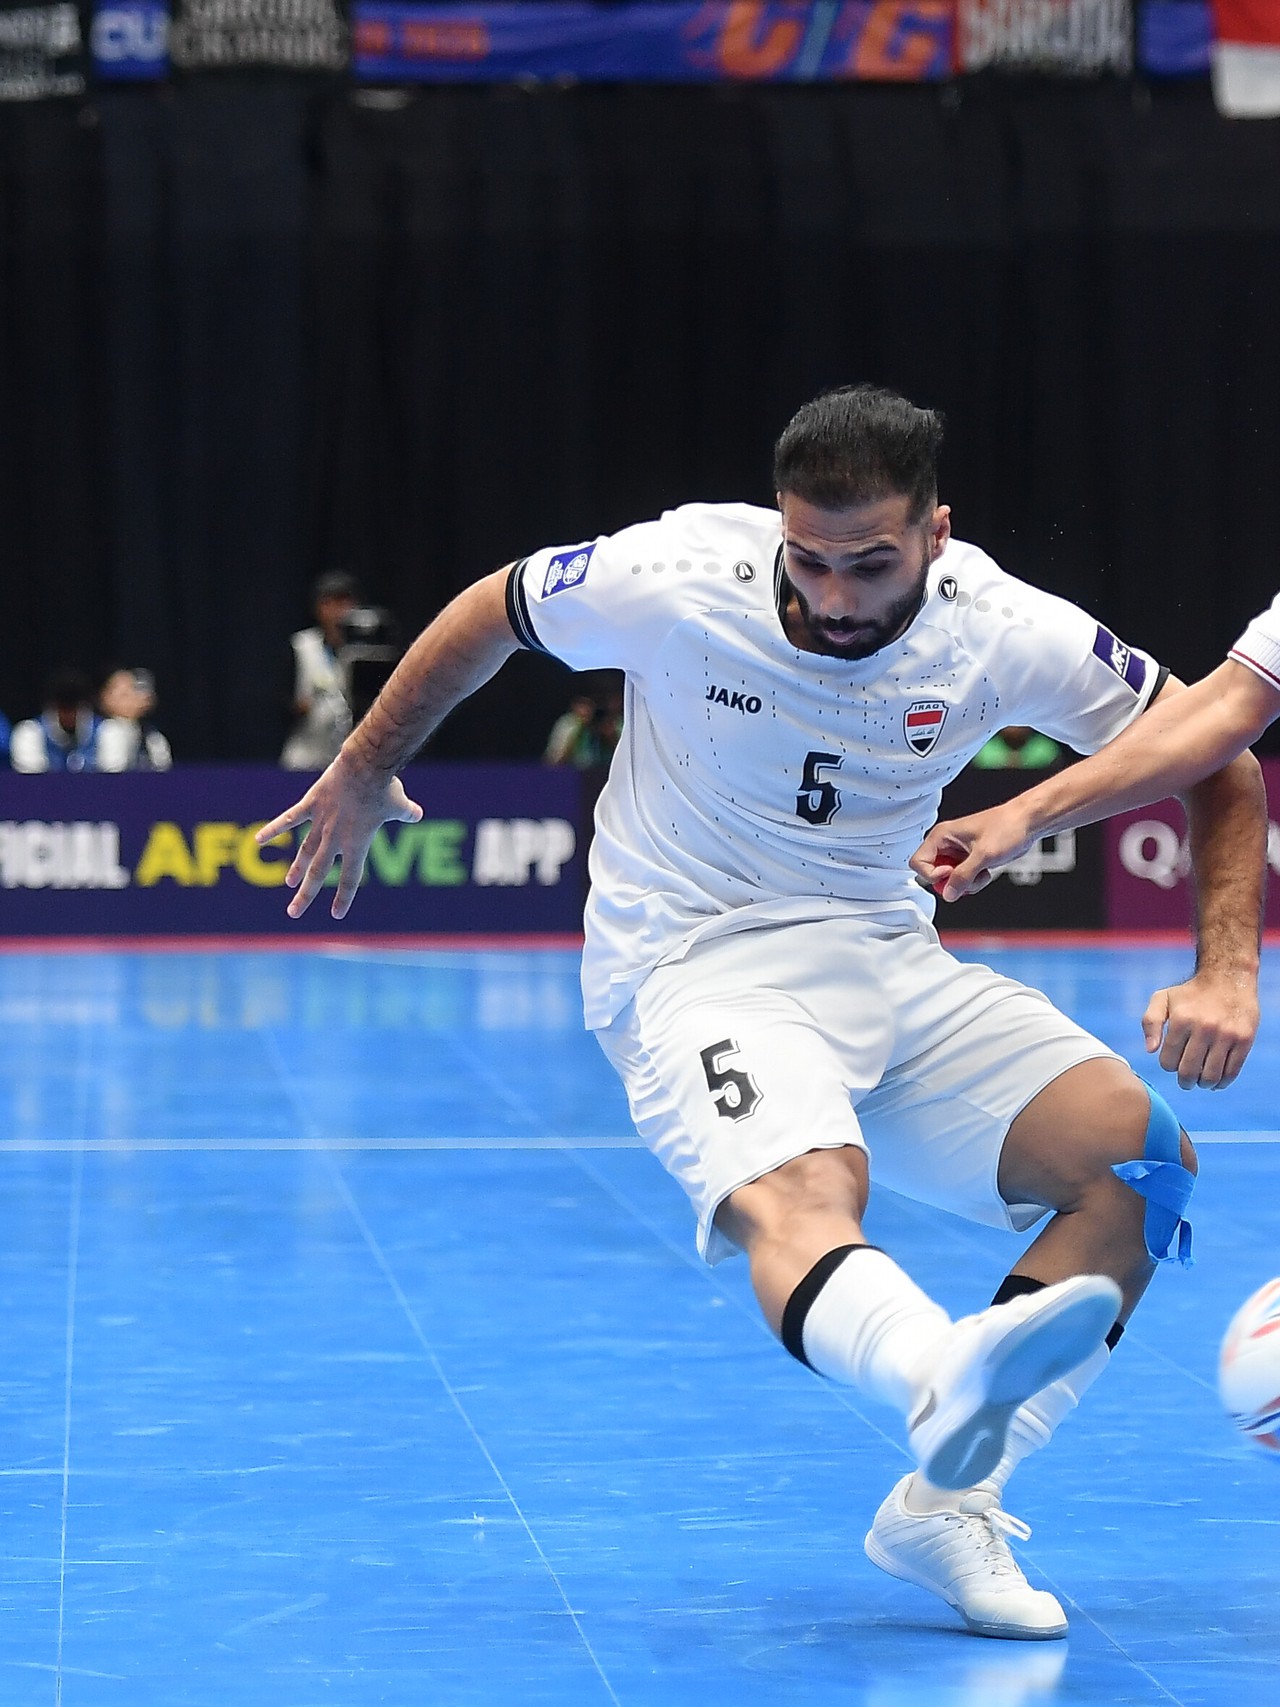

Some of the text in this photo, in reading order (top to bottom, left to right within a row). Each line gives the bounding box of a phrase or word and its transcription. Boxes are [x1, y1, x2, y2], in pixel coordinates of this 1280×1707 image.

[705, 684, 763, 715] JAKO
[914, 703, 940, 712] IRAQ
[796, 751, 845, 825] 5
[136, 821, 292, 887] AFC
[472, 817, 576, 887] APP
[700, 1037, 765, 1124] 5
